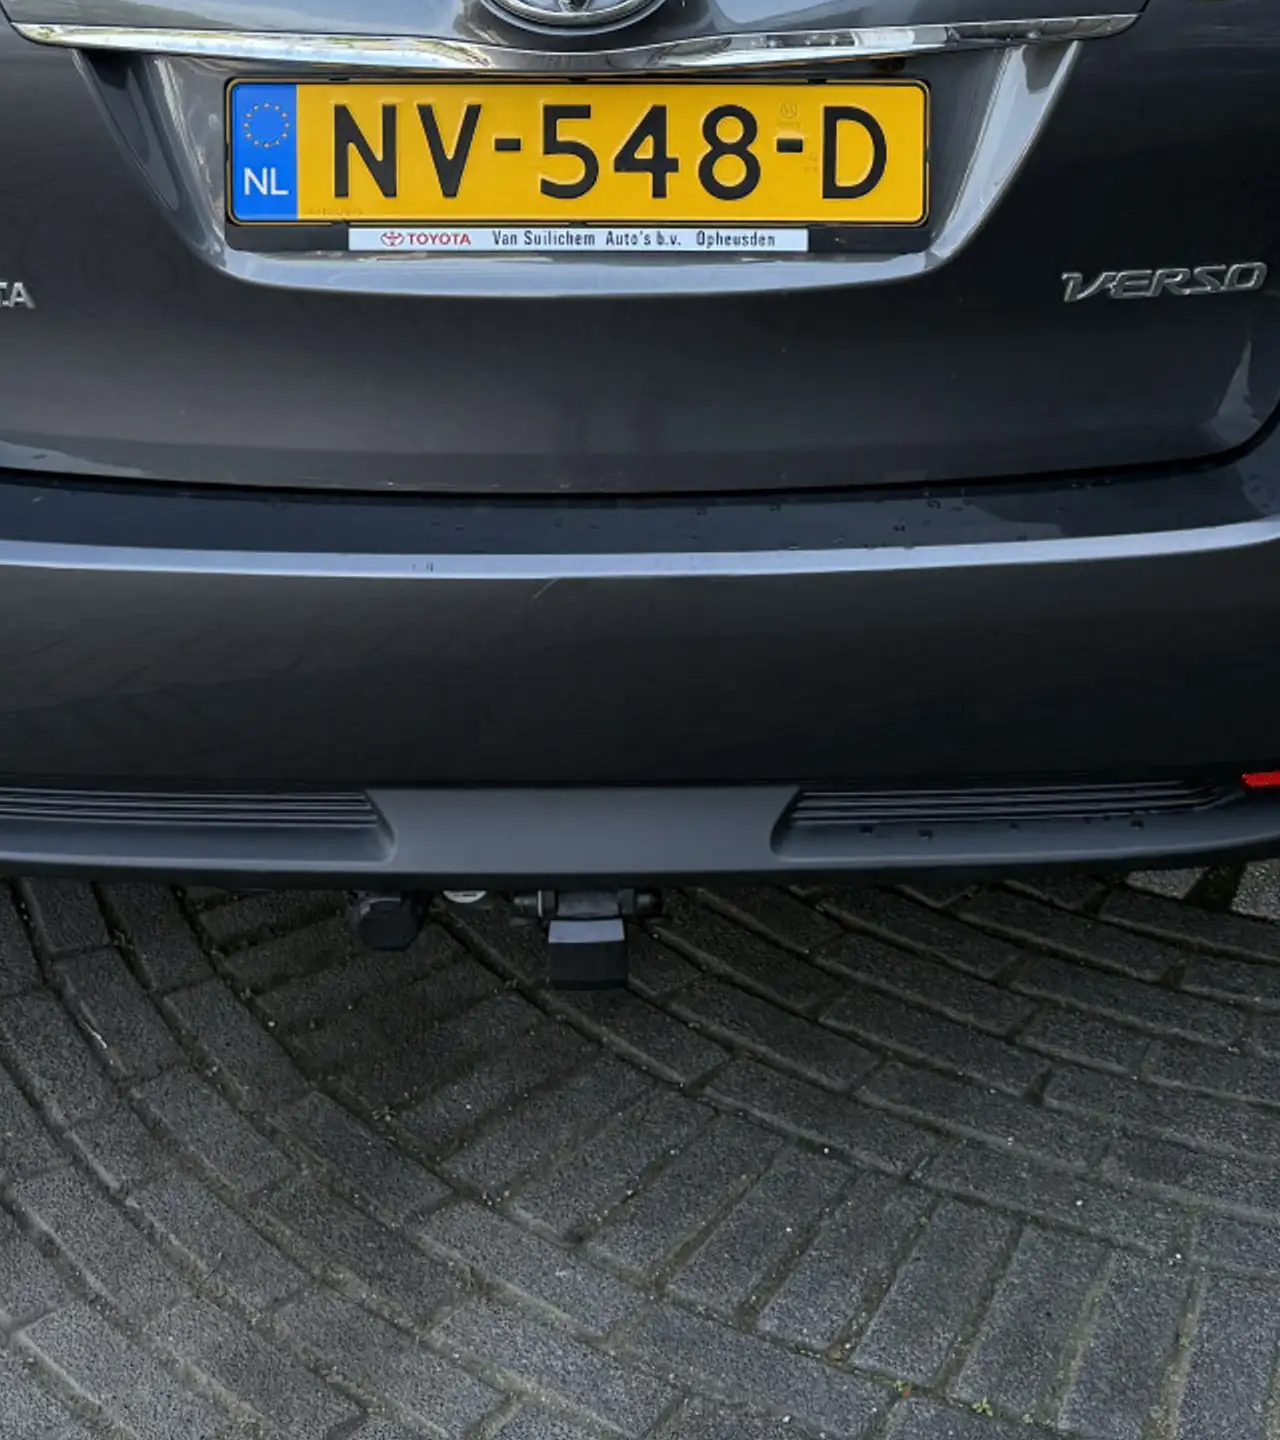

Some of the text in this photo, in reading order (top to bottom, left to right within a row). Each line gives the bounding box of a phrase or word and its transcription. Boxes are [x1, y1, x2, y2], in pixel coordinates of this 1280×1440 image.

[333, 104, 887, 201] NV-548-D
[244, 167, 289, 195] NL
[407, 232, 471, 245] TOYOTA
[492, 230, 776, 248] Van Suilichem Auto's b.v. Opheusden
[1061, 261, 1267, 302] VERSO
